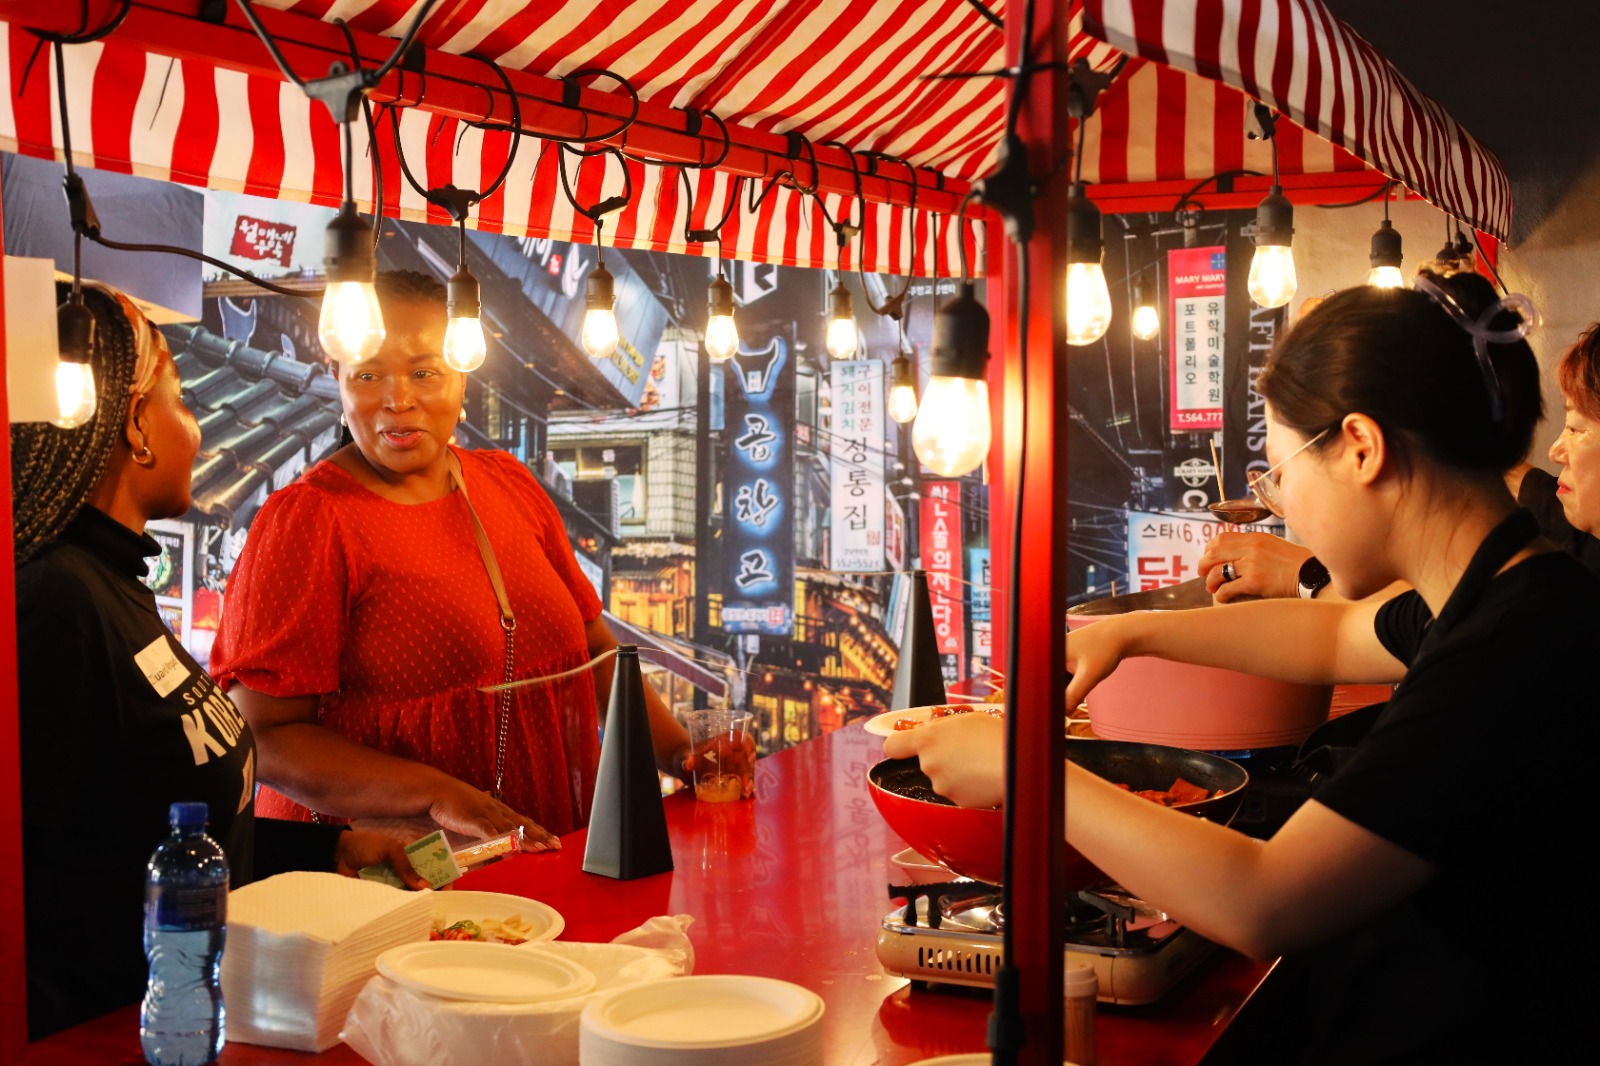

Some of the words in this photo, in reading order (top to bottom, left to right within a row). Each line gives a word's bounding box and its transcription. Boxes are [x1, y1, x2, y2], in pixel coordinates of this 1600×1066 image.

[1184, 303, 1197, 385] 포트폴리오
[1207, 301, 1220, 402] 유학미술학원
[858, 363, 871, 431] 구이전문
[735, 413, 778, 587] 곱창고
[843, 437, 871, 530] 정통집
[181, 685, 246, 766] KORE
[183, 670, 213, 705] SOUT
